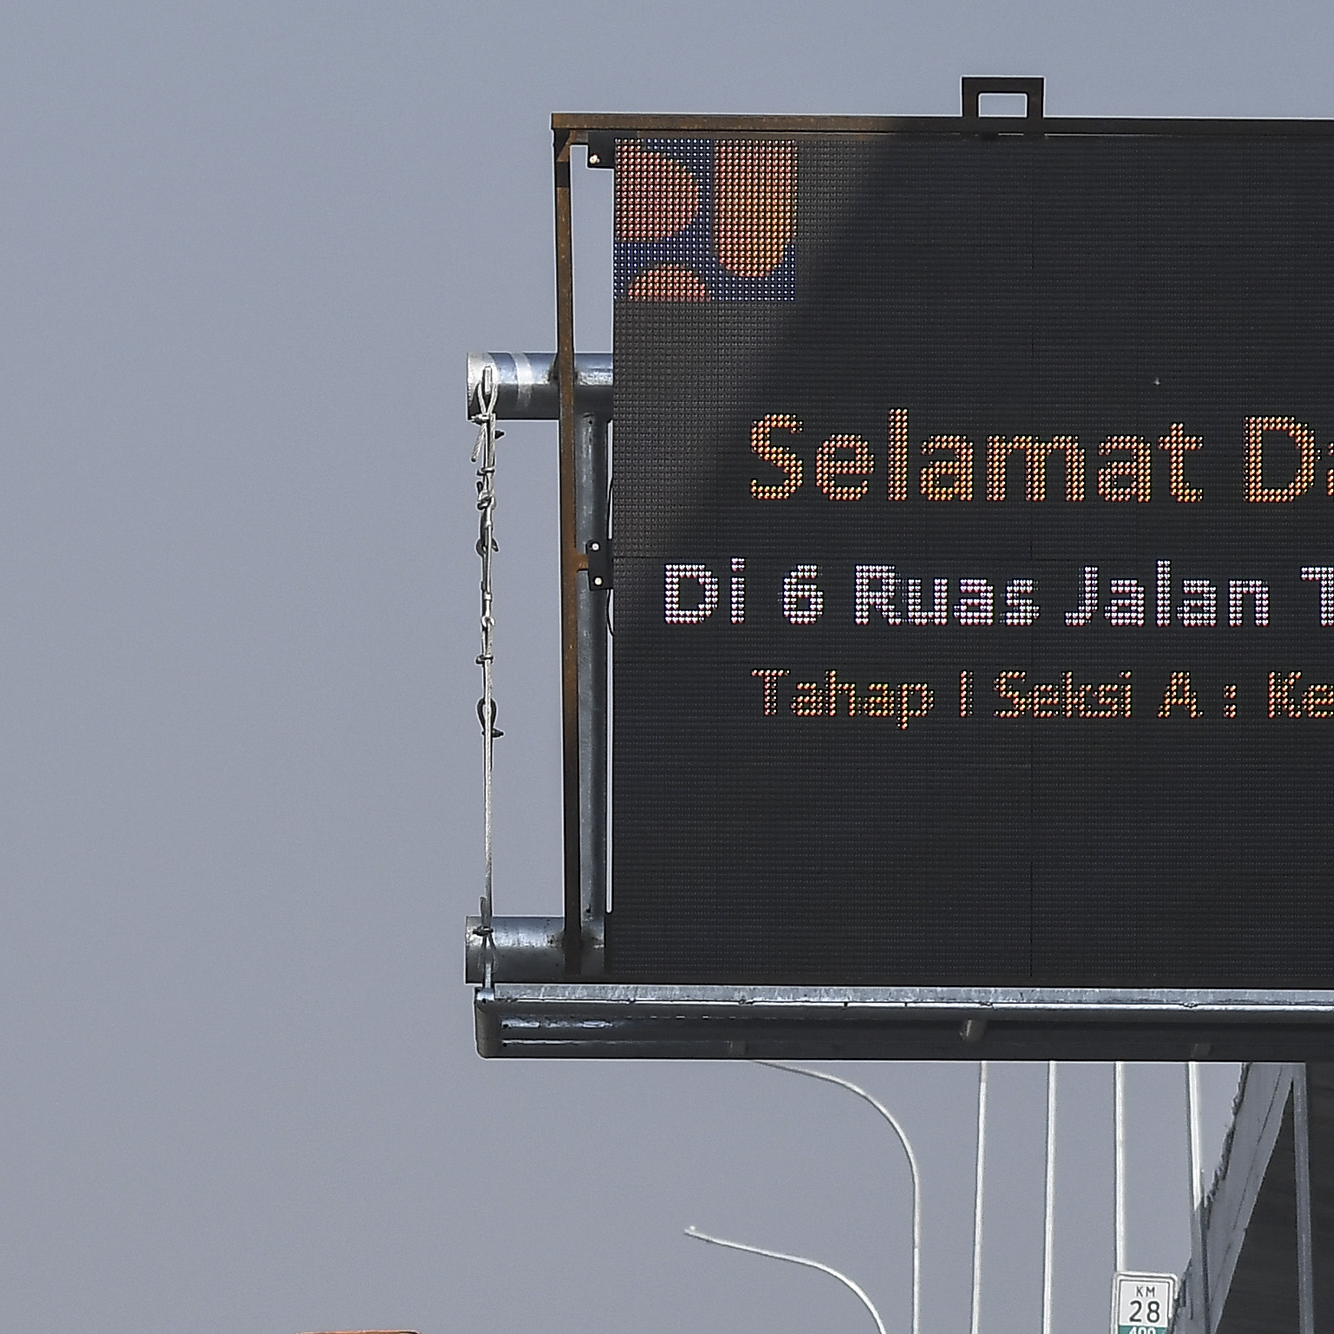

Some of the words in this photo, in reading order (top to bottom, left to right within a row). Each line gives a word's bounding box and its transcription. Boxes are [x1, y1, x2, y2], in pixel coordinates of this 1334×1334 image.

[749, 408, 1203, 503] Selamat
[663, 557, 745, 625] Di
[777, 564, 824, 625] 6
[854, 564, 1040, 626] Ruas
[1064, 560, 1269, 627] Jalan
[750, 669, 934, 730] Tahap
[993, 670, 1132, 718] Seksi
[1156, 671, 1203, 718] A
[1129, 1300, 1160, 1323] 28
[1136, 1286, 1156, 1298] KM
